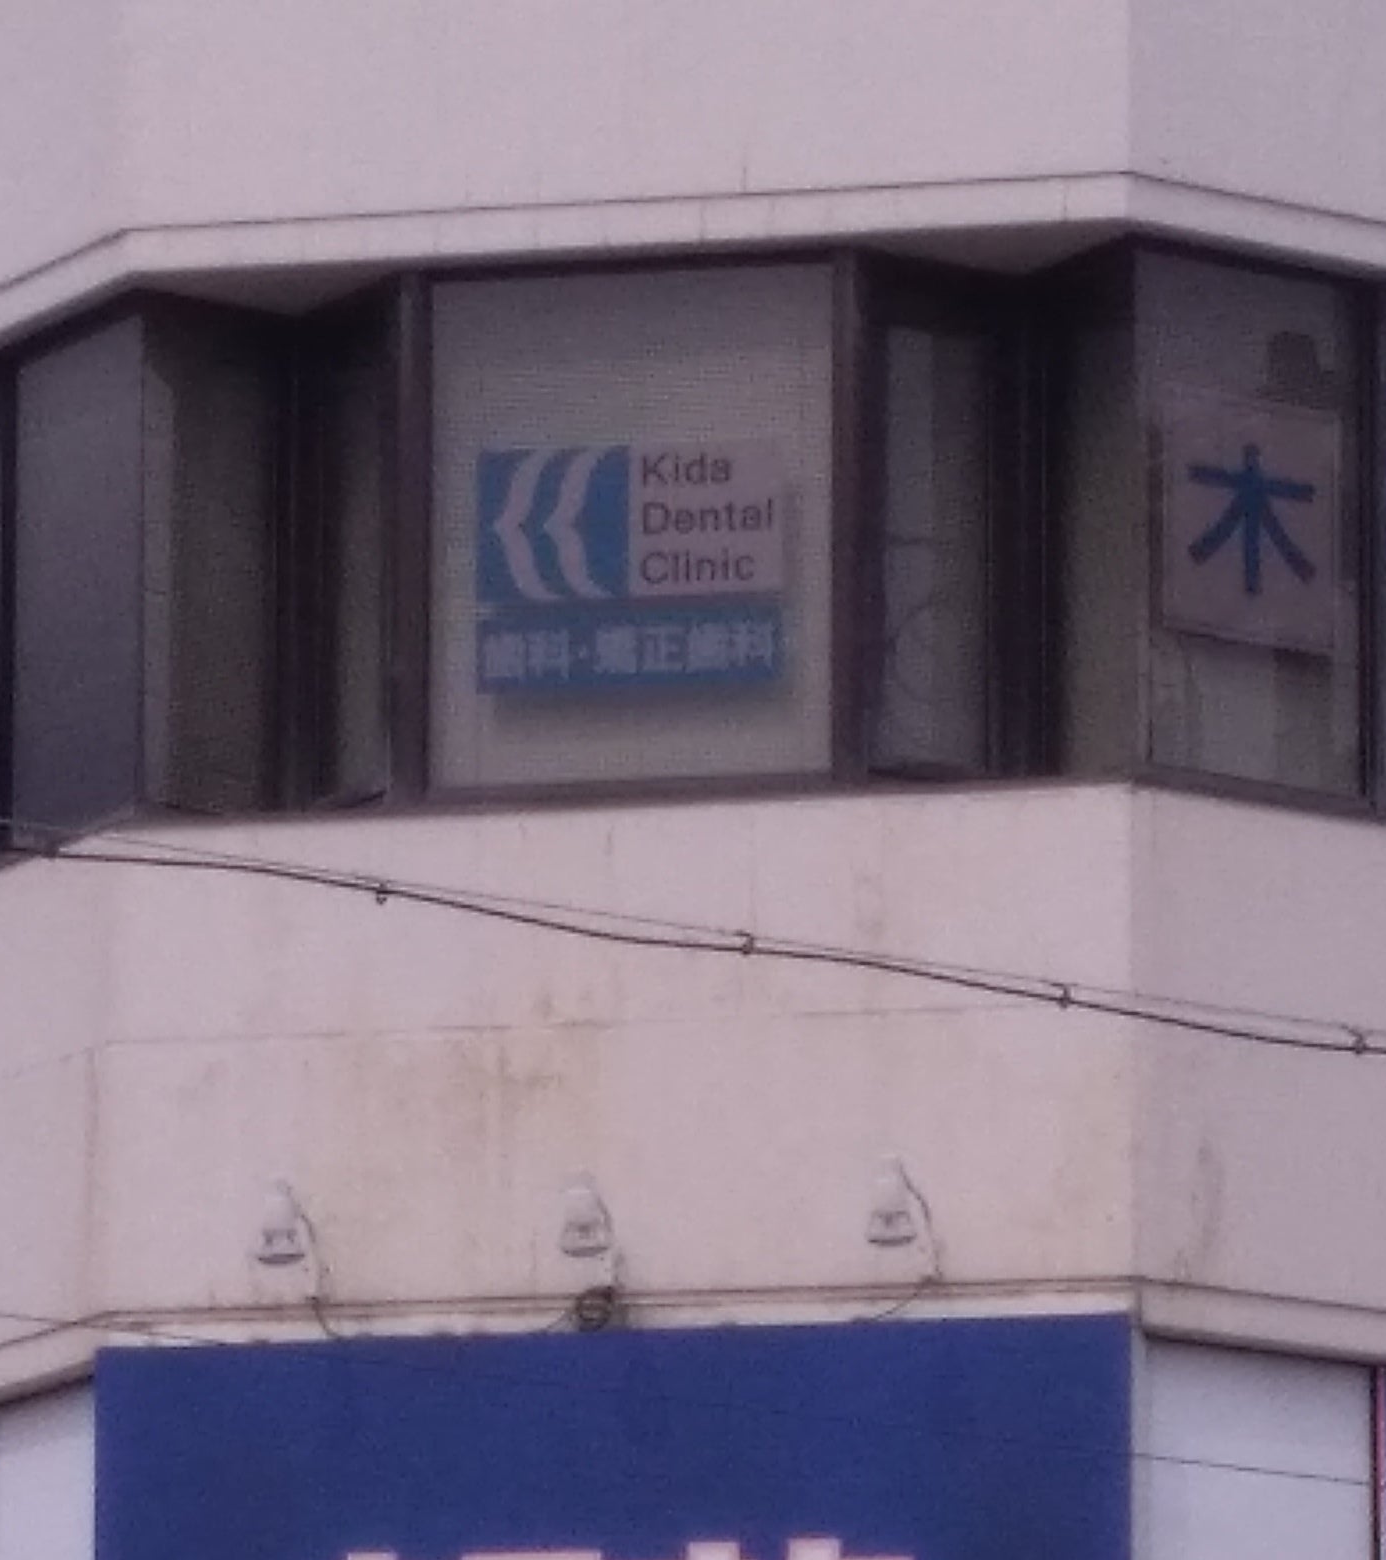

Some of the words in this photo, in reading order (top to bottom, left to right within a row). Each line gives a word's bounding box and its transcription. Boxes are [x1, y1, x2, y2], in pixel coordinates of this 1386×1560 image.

[641, 453, 732, 485] Kida
[642, 500, 773, 535] Dental
[640, 548, 755, 585] Clinic
